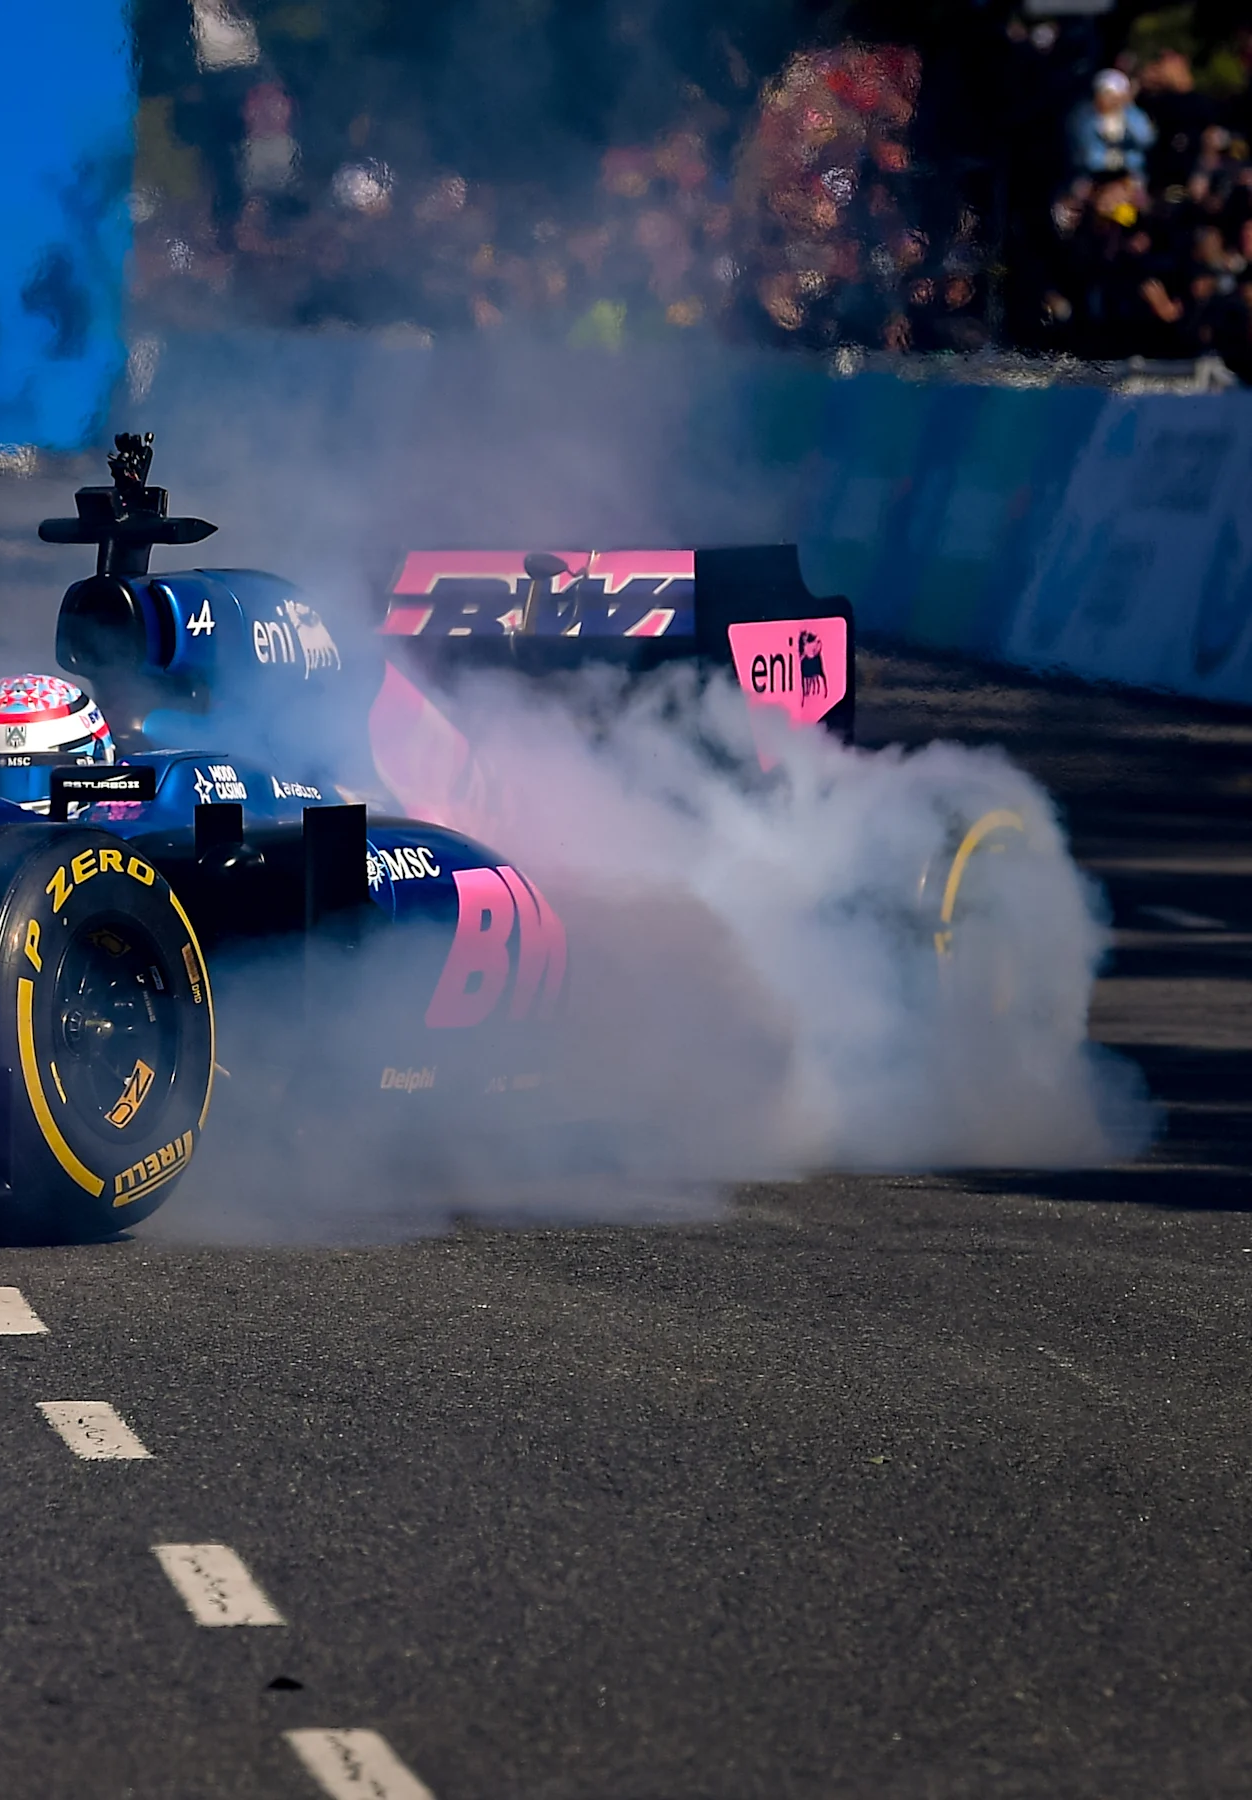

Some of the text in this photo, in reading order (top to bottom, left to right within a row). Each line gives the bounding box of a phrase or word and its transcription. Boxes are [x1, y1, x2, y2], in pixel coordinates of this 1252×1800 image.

[253, 605, 296, 664] eni
[751, 636, 794, 693] eni
[7, 756, 31, 767] MSC
[215, 781, 248, 800] CASINO
[378, 846, 441, 881] MSC
[24, 918, 43, 973] P
[45, 848, 156, 914] ZERO
[380, 1066, 437, 1094] Delphi
[112, 1129, 194, 1208] PIRELLI
